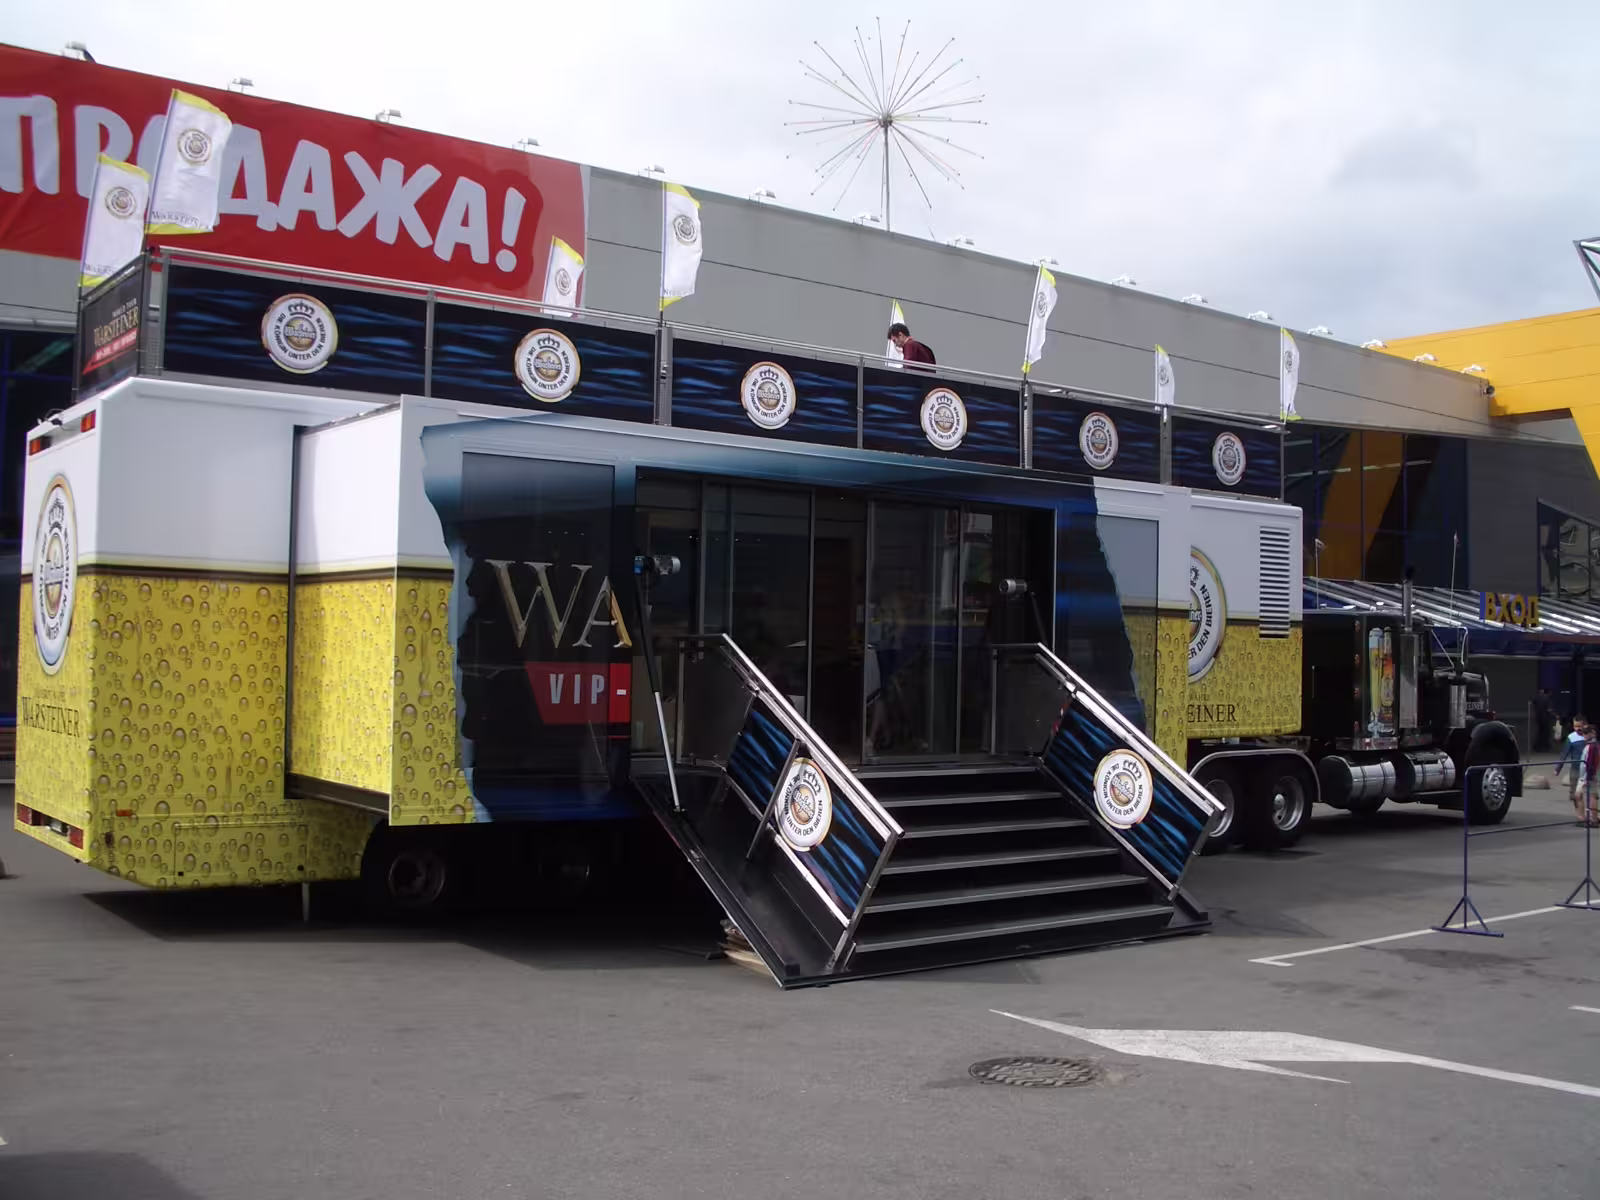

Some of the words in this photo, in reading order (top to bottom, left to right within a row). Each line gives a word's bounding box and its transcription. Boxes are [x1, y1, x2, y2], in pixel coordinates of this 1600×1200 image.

[288, 351, 312, 360] UNTER
[538, 381, 558, 390] UNTER
[484, 558, 633, 649] WA
[1200, 584, 1212, 628] BIEREN
[1485, 592, 1539, 628] ВХОД
[1196, 630, 1210, 652] DEN
[22, 696, 80, 738] WARSTEINER
[1111, 763, 1120, 772] DIE
[1105, 799, 1122, 816] UNTER
[1122, 807, 1134, 816] DEN
[787, 815, 802, 836] UNTER
[802, 826, 814, 836] DEN
